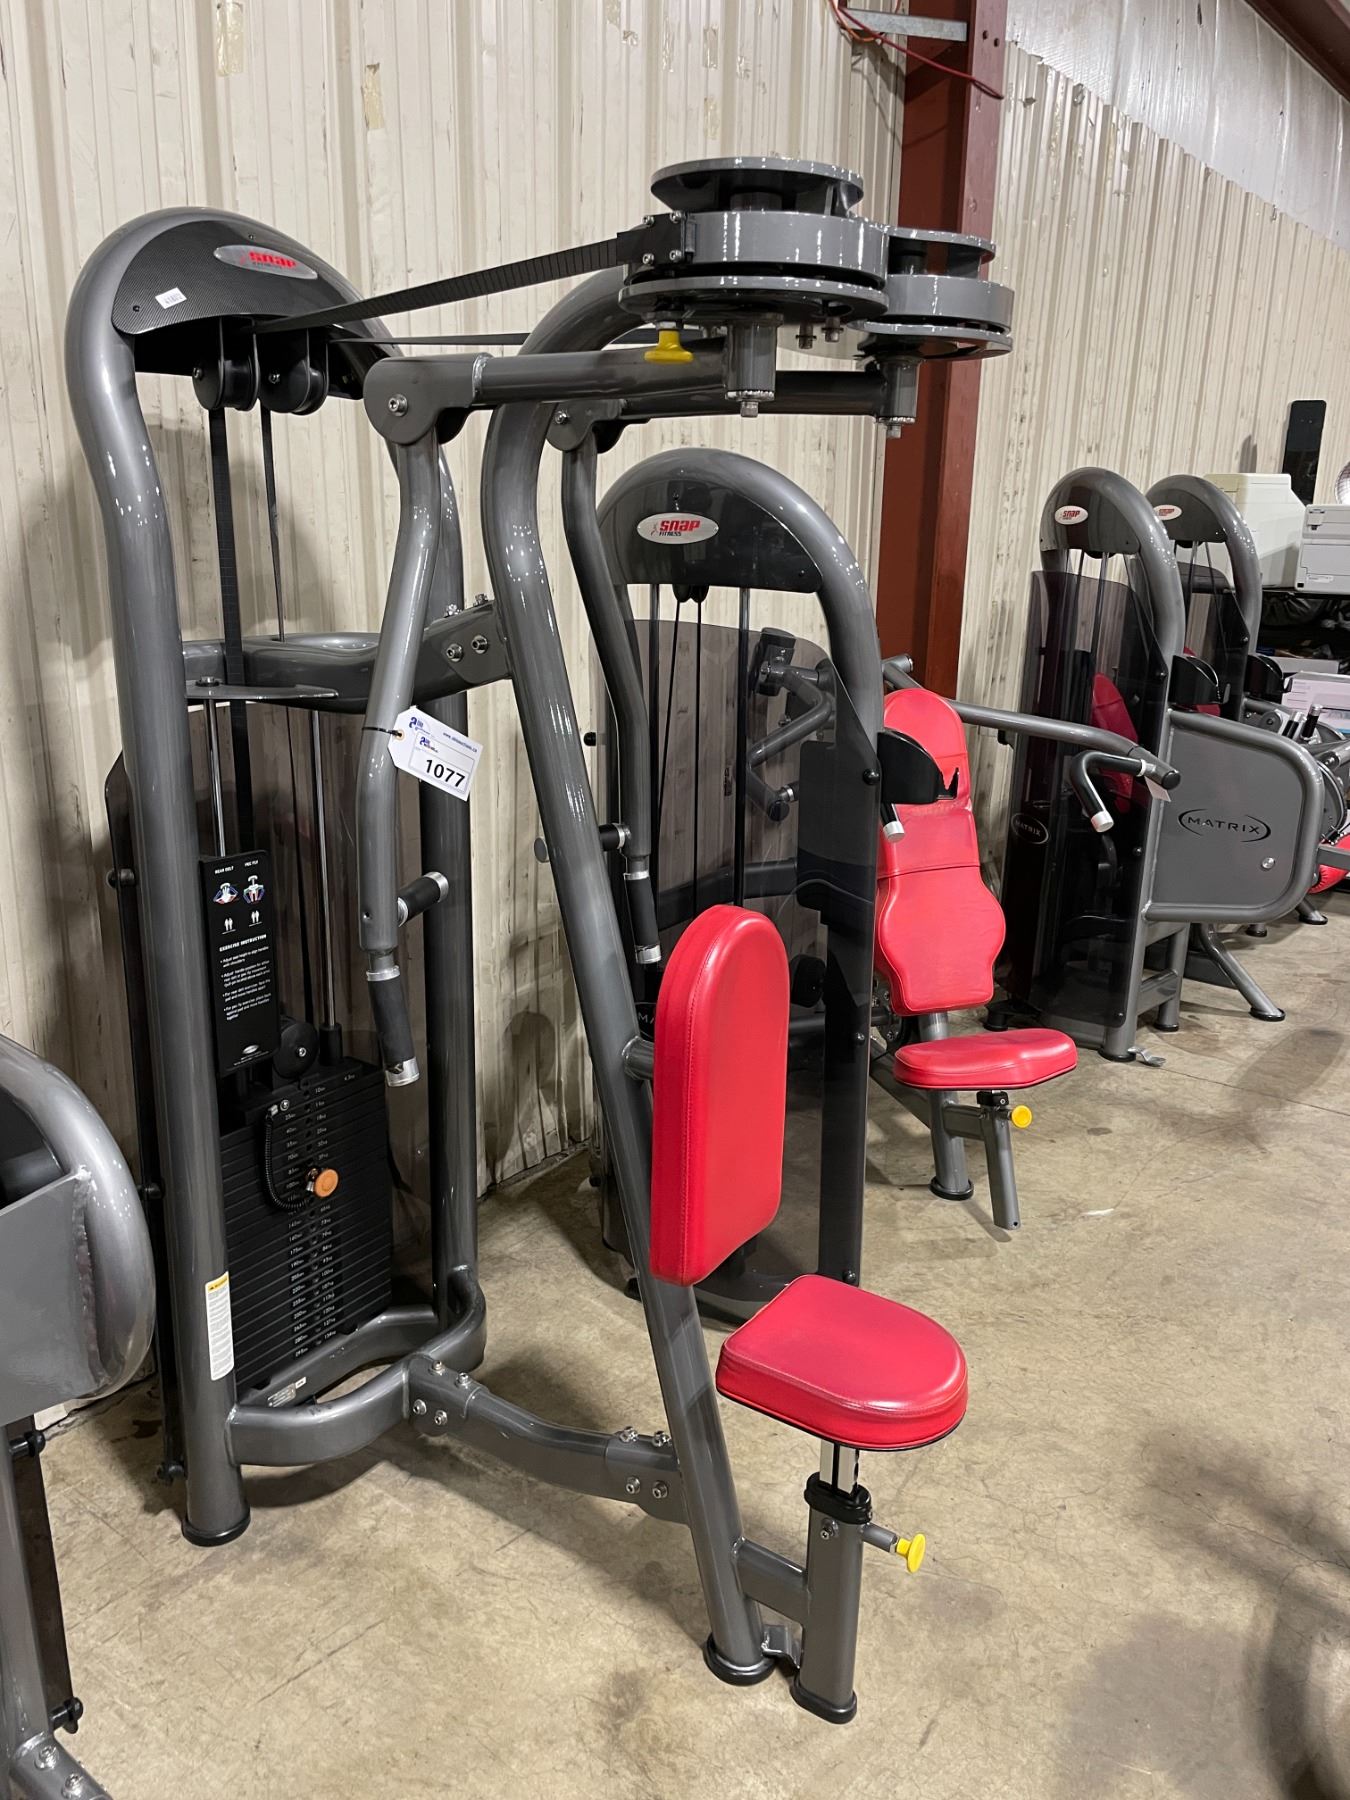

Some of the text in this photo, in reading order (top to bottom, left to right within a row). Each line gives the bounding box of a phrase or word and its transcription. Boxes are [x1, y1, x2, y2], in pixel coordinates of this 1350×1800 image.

[426, 759, 465, 787] 1077
[1014, 818, 1041, 837] MATRIX
[1187, 816, 1260, 835] MATRIX
